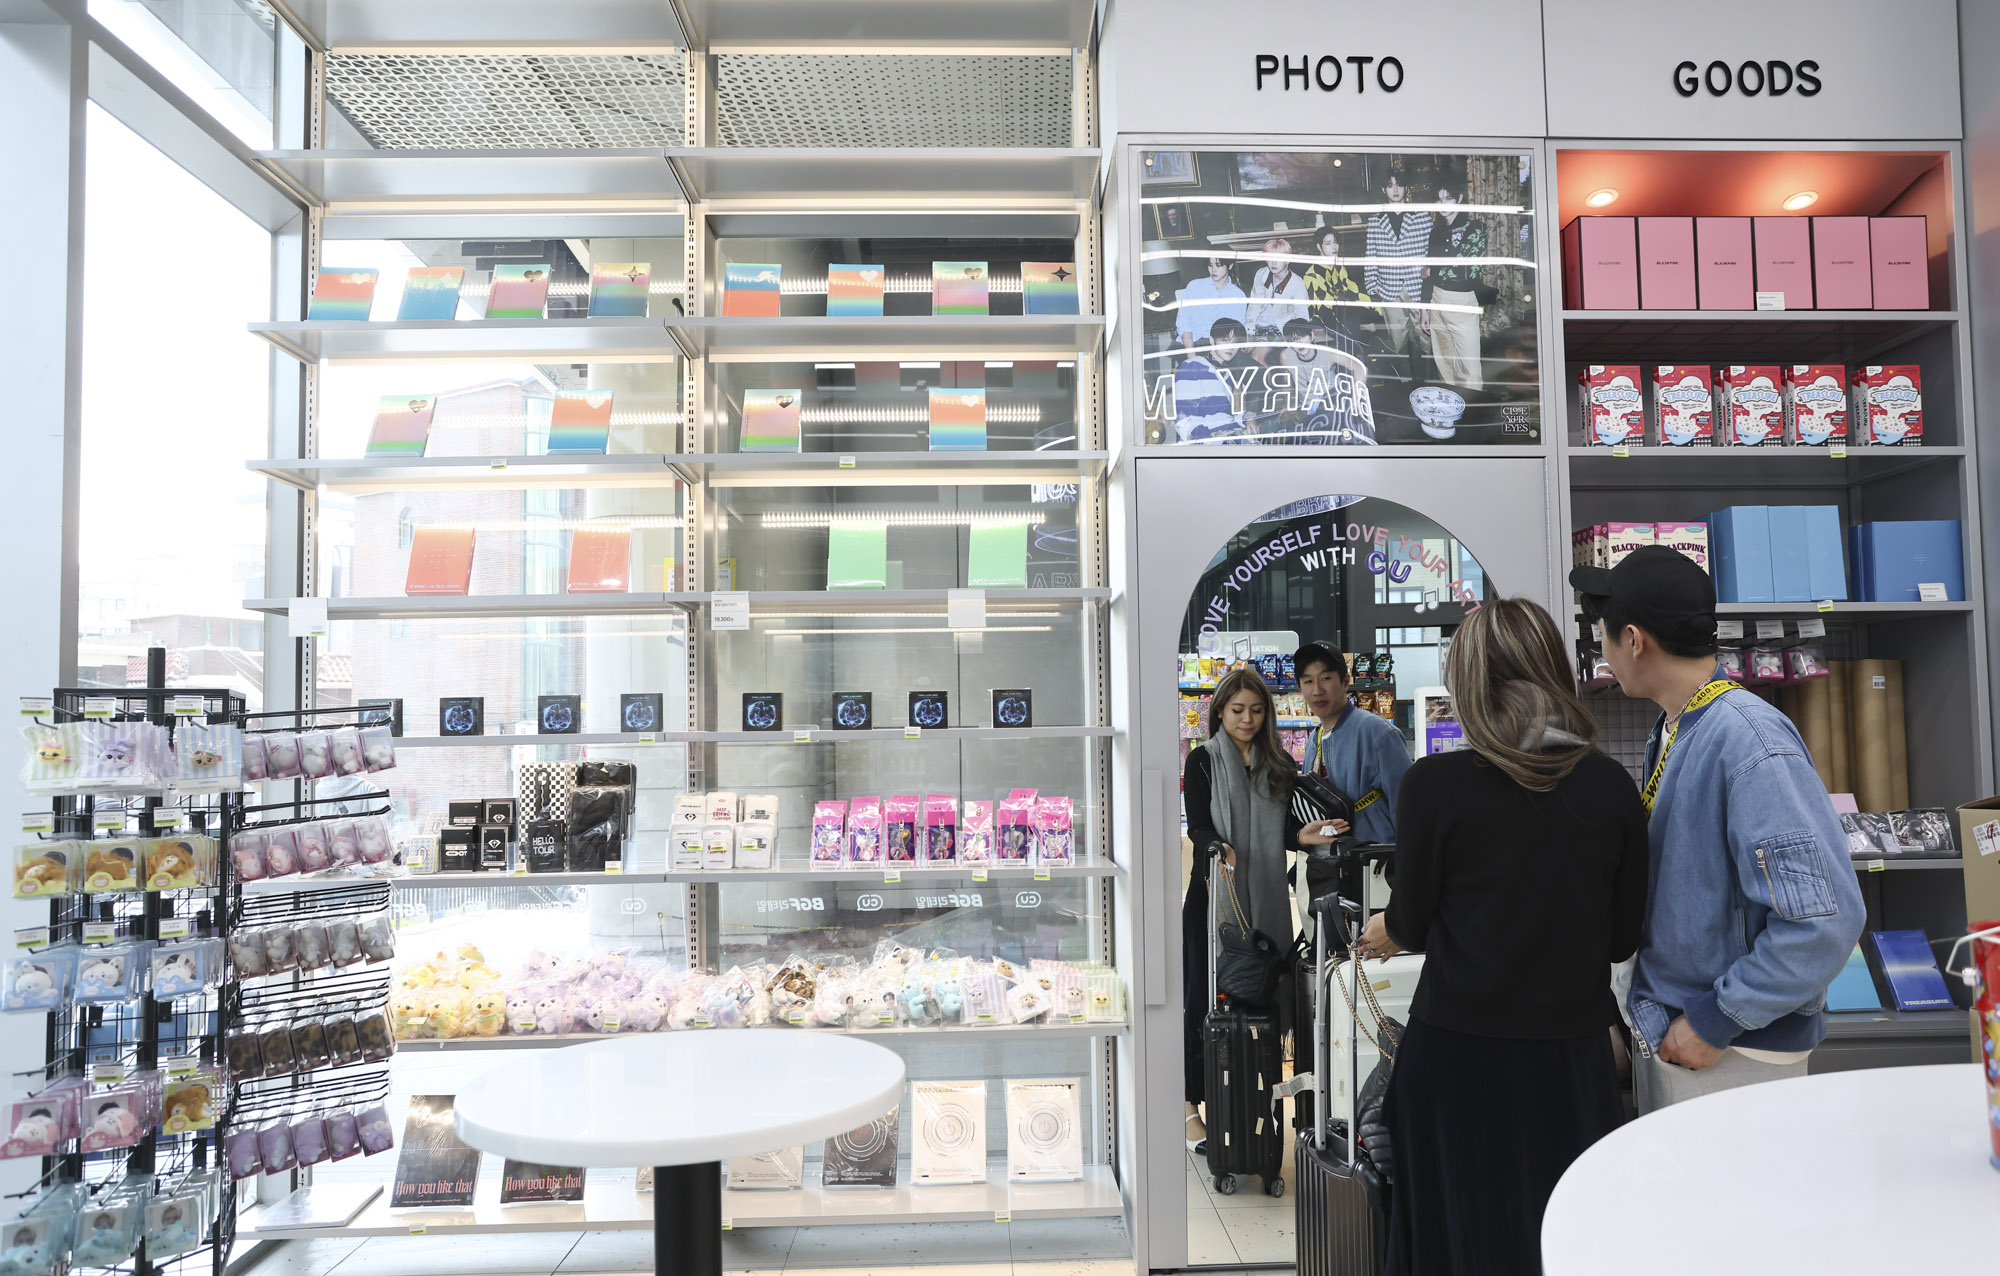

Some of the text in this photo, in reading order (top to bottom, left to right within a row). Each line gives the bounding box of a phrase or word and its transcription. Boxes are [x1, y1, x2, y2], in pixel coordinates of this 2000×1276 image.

[1256, 55, 1404, 93] PHOTO
[1674, 60, 1822, 97] GOODS
[1597, 390, 1638, 402] TREASURE
[1666, 390, 1707, 402] TREASURE
[1737, 390, 1778, 402] TREASURE
[1800, 390, 1841, 402] TREASURE
[1875, 390, 1916, 402] TREASURE
[1502, 406, 1529, 415] CLOSE
[1504, 423, 1529, 432] EYES
[1611, 543, 1646, 553] BLACKP
[1667, 542, 1706, 553] ACKPINK
[1300, 547, 1412, 584] WITH CU
[1196, 595, 1231, 653] LOVE
[1223, 525, 1322, 592] YOURSELF
[1332, 523, 1390, 546] LOVE
[1399, 534, 1449, 578] YOUR
[532, 836, 555, 845] HELLO
[533, 846, 555, 854] TOUR
[1904, 998, 1950, 1006] TREASURE
[395, 1179, 473, 1198] How you like that
[505, 1175, 582, 1193] How you like that
